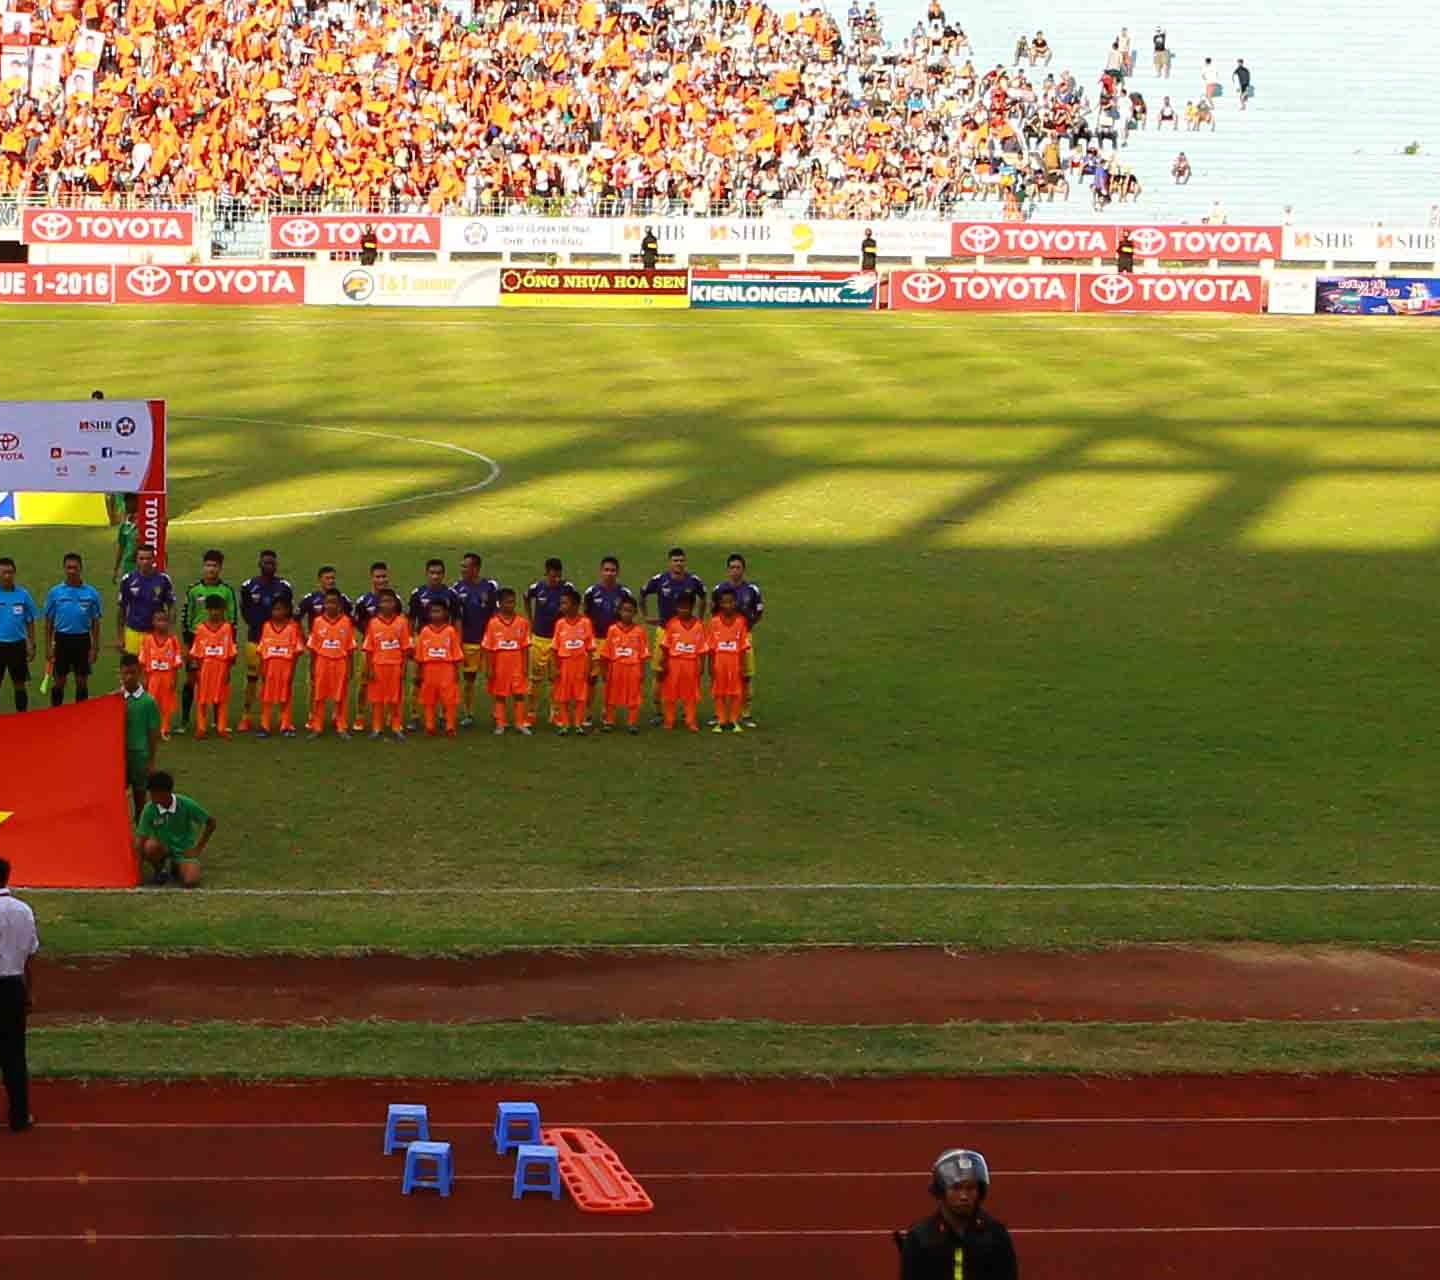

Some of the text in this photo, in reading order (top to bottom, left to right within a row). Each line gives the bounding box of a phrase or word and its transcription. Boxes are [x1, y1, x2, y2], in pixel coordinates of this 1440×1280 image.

[74, 219, 184, 240] TOYOTA
[731, 224, 772, 240] SHB
[1004, 230, 1108, 251] TOYOTA
[1168, 232, 1273, 253] TOYOTA
[1312, 232, 1354, 249] SHB
[1396, 232, 1437, 249] SHB
[32, 271, 110, 295] 1-2016
[175, 269, 296, 293] TOYOTA
[523, 268, 686, 292] ỐNG NHỰA HOA SEN
[950, 277, 1067, 300] TOYOTA
[1138, 278, 1253, 301] TOYOTA
[691, 285, 842, 303] KIENLONGBANK
